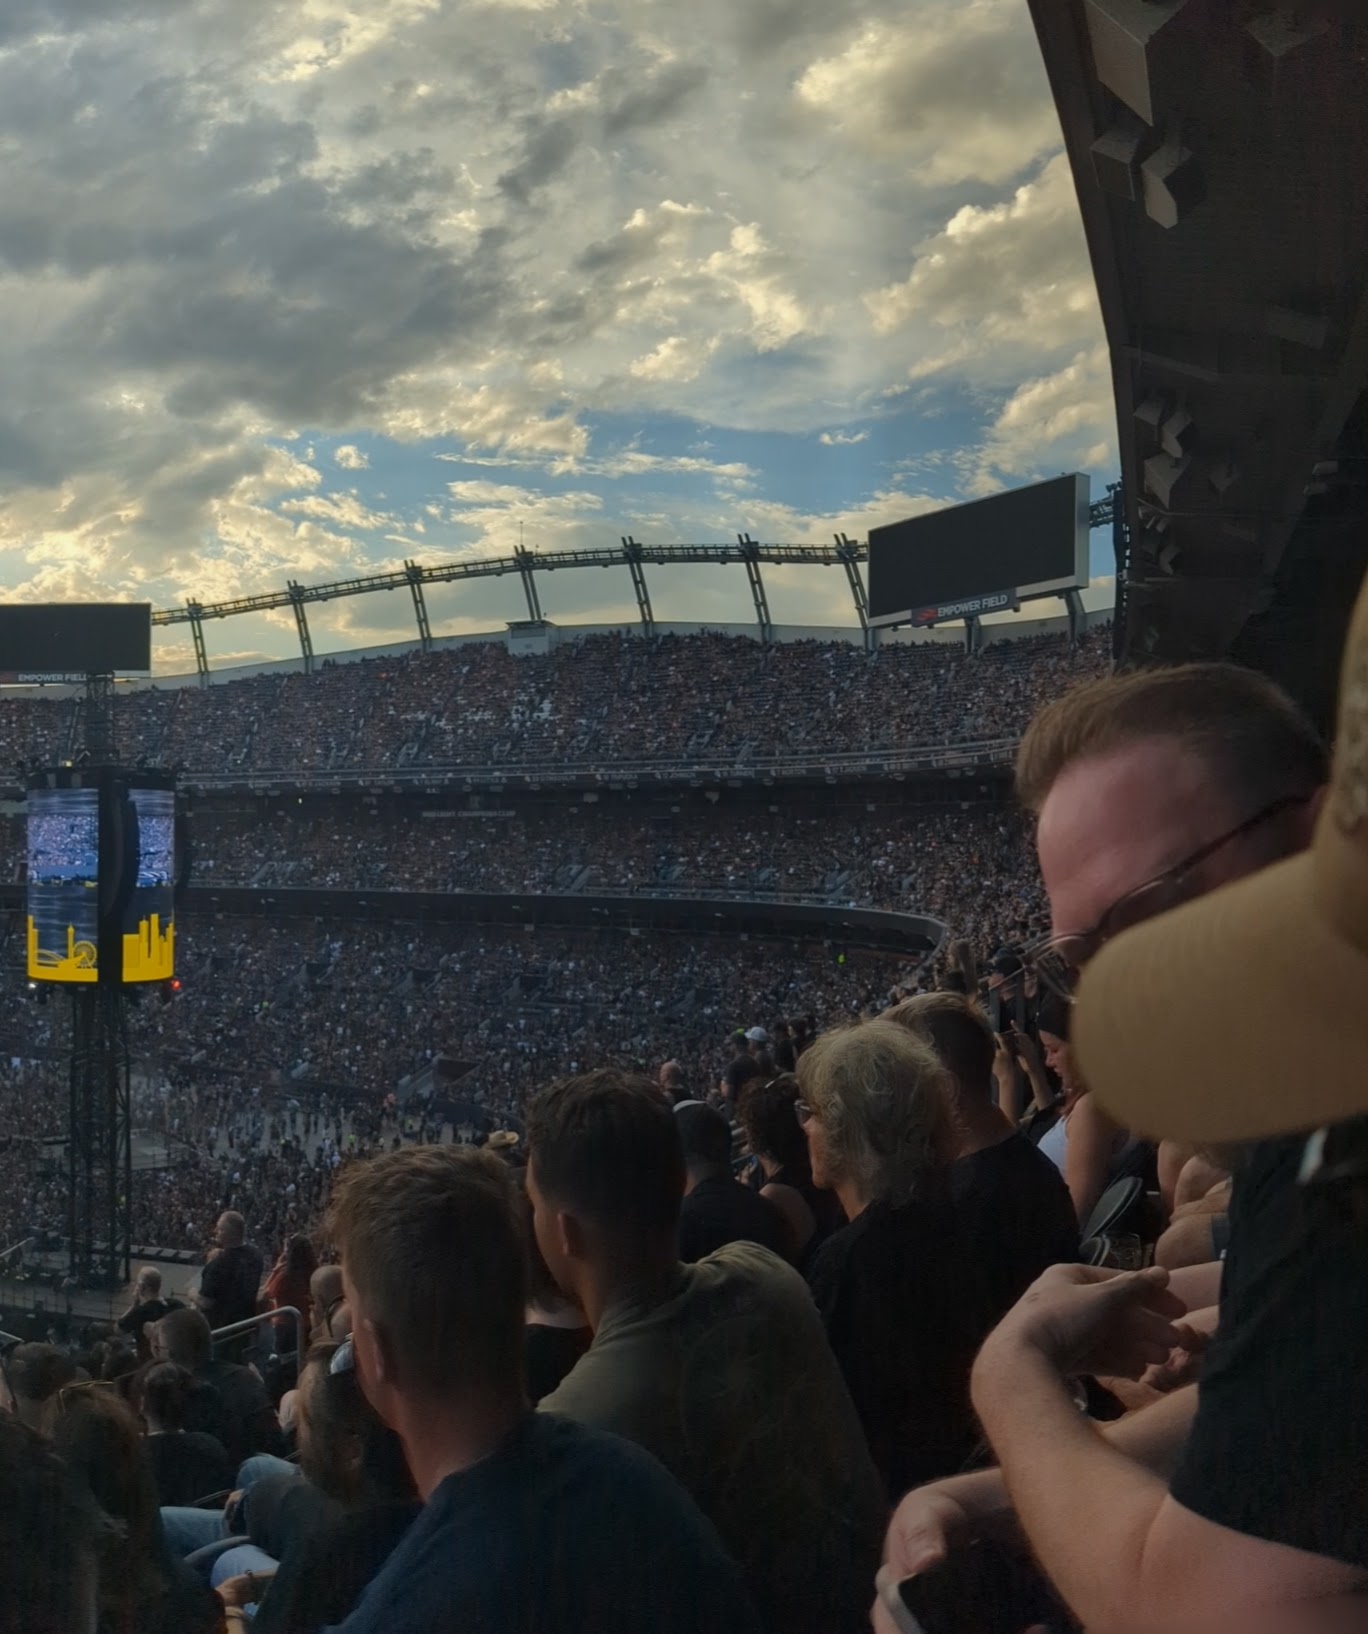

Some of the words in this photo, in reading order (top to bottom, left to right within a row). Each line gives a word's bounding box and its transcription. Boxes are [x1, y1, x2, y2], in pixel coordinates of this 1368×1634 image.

[937, 600, 981, 617] EMPOWER
[982, 595, 1008, 609] FIELD
[18, 673, 64, 682] EMPOWER
[65, 673, 91, 682] FIEL
